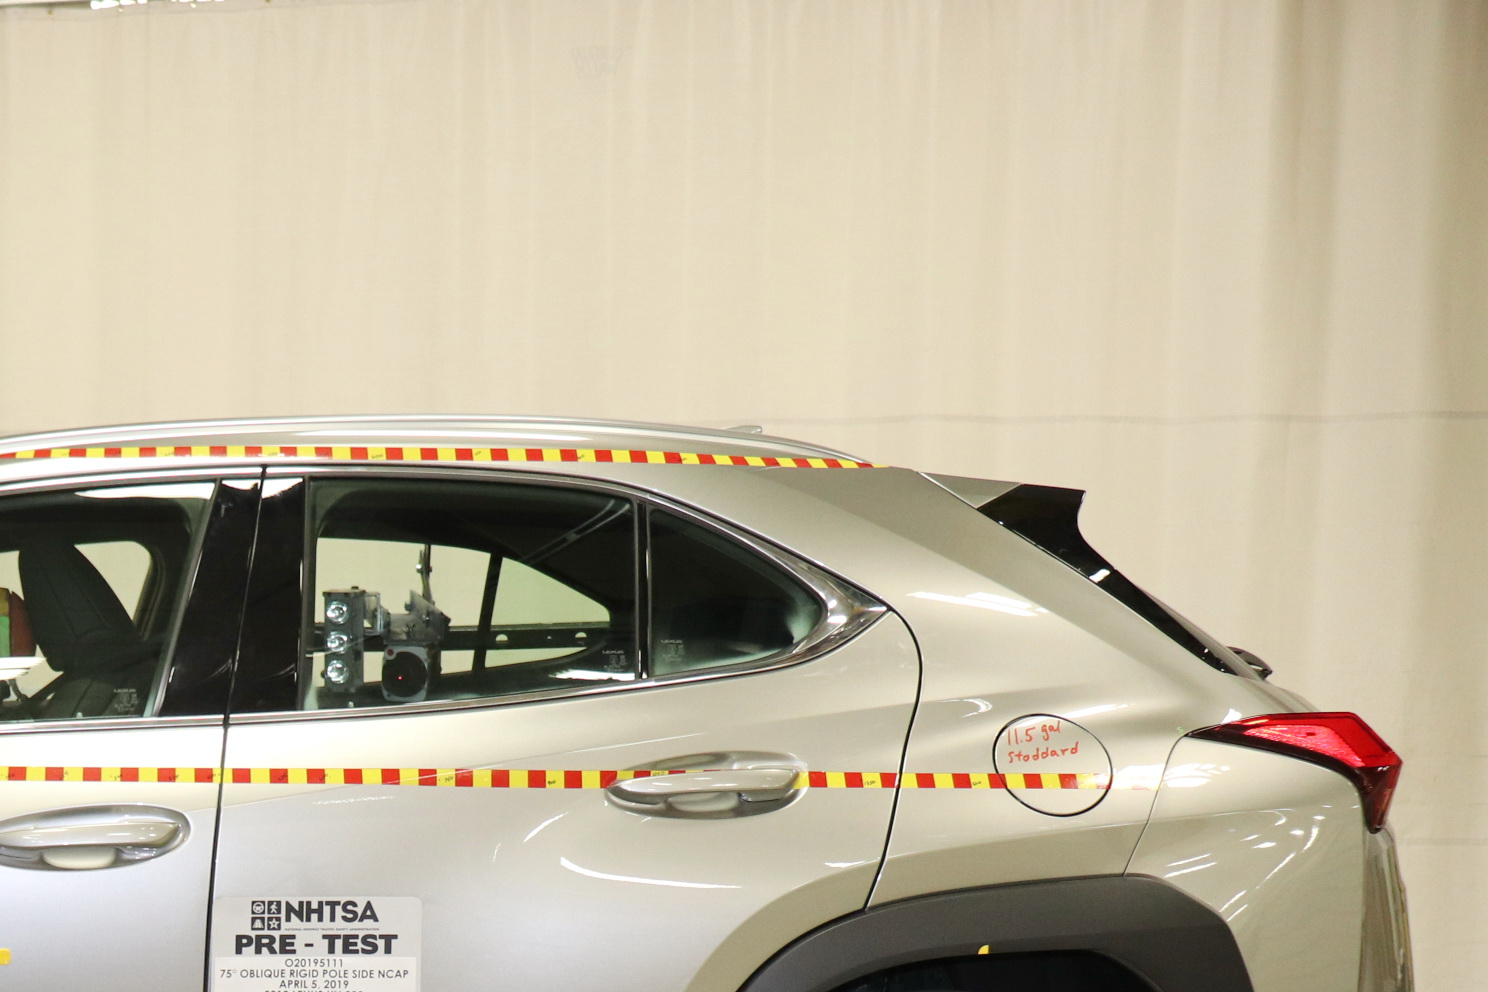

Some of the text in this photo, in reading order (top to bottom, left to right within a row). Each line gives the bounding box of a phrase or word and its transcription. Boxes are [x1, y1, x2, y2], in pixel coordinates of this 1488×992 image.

[1007, 720, 1061, 745] 11.5 gal
[1007, 741, 1079, 763] Stoddard
[285, 900, 379, 923] NHTSA
[235, 934, 297, 955] PRE
[322, 934, 398, 955] TEST
[240, 969, 286, 979] OBLIQUE
[289, 969, 319, 979] RIGID
[322, 969, 349, 979] POLE
[352, 969, 375, 979] SIDE
[378, 969, 409, 979] NCAP
[279, 980, 350, 990] APRIL 5, 2019
